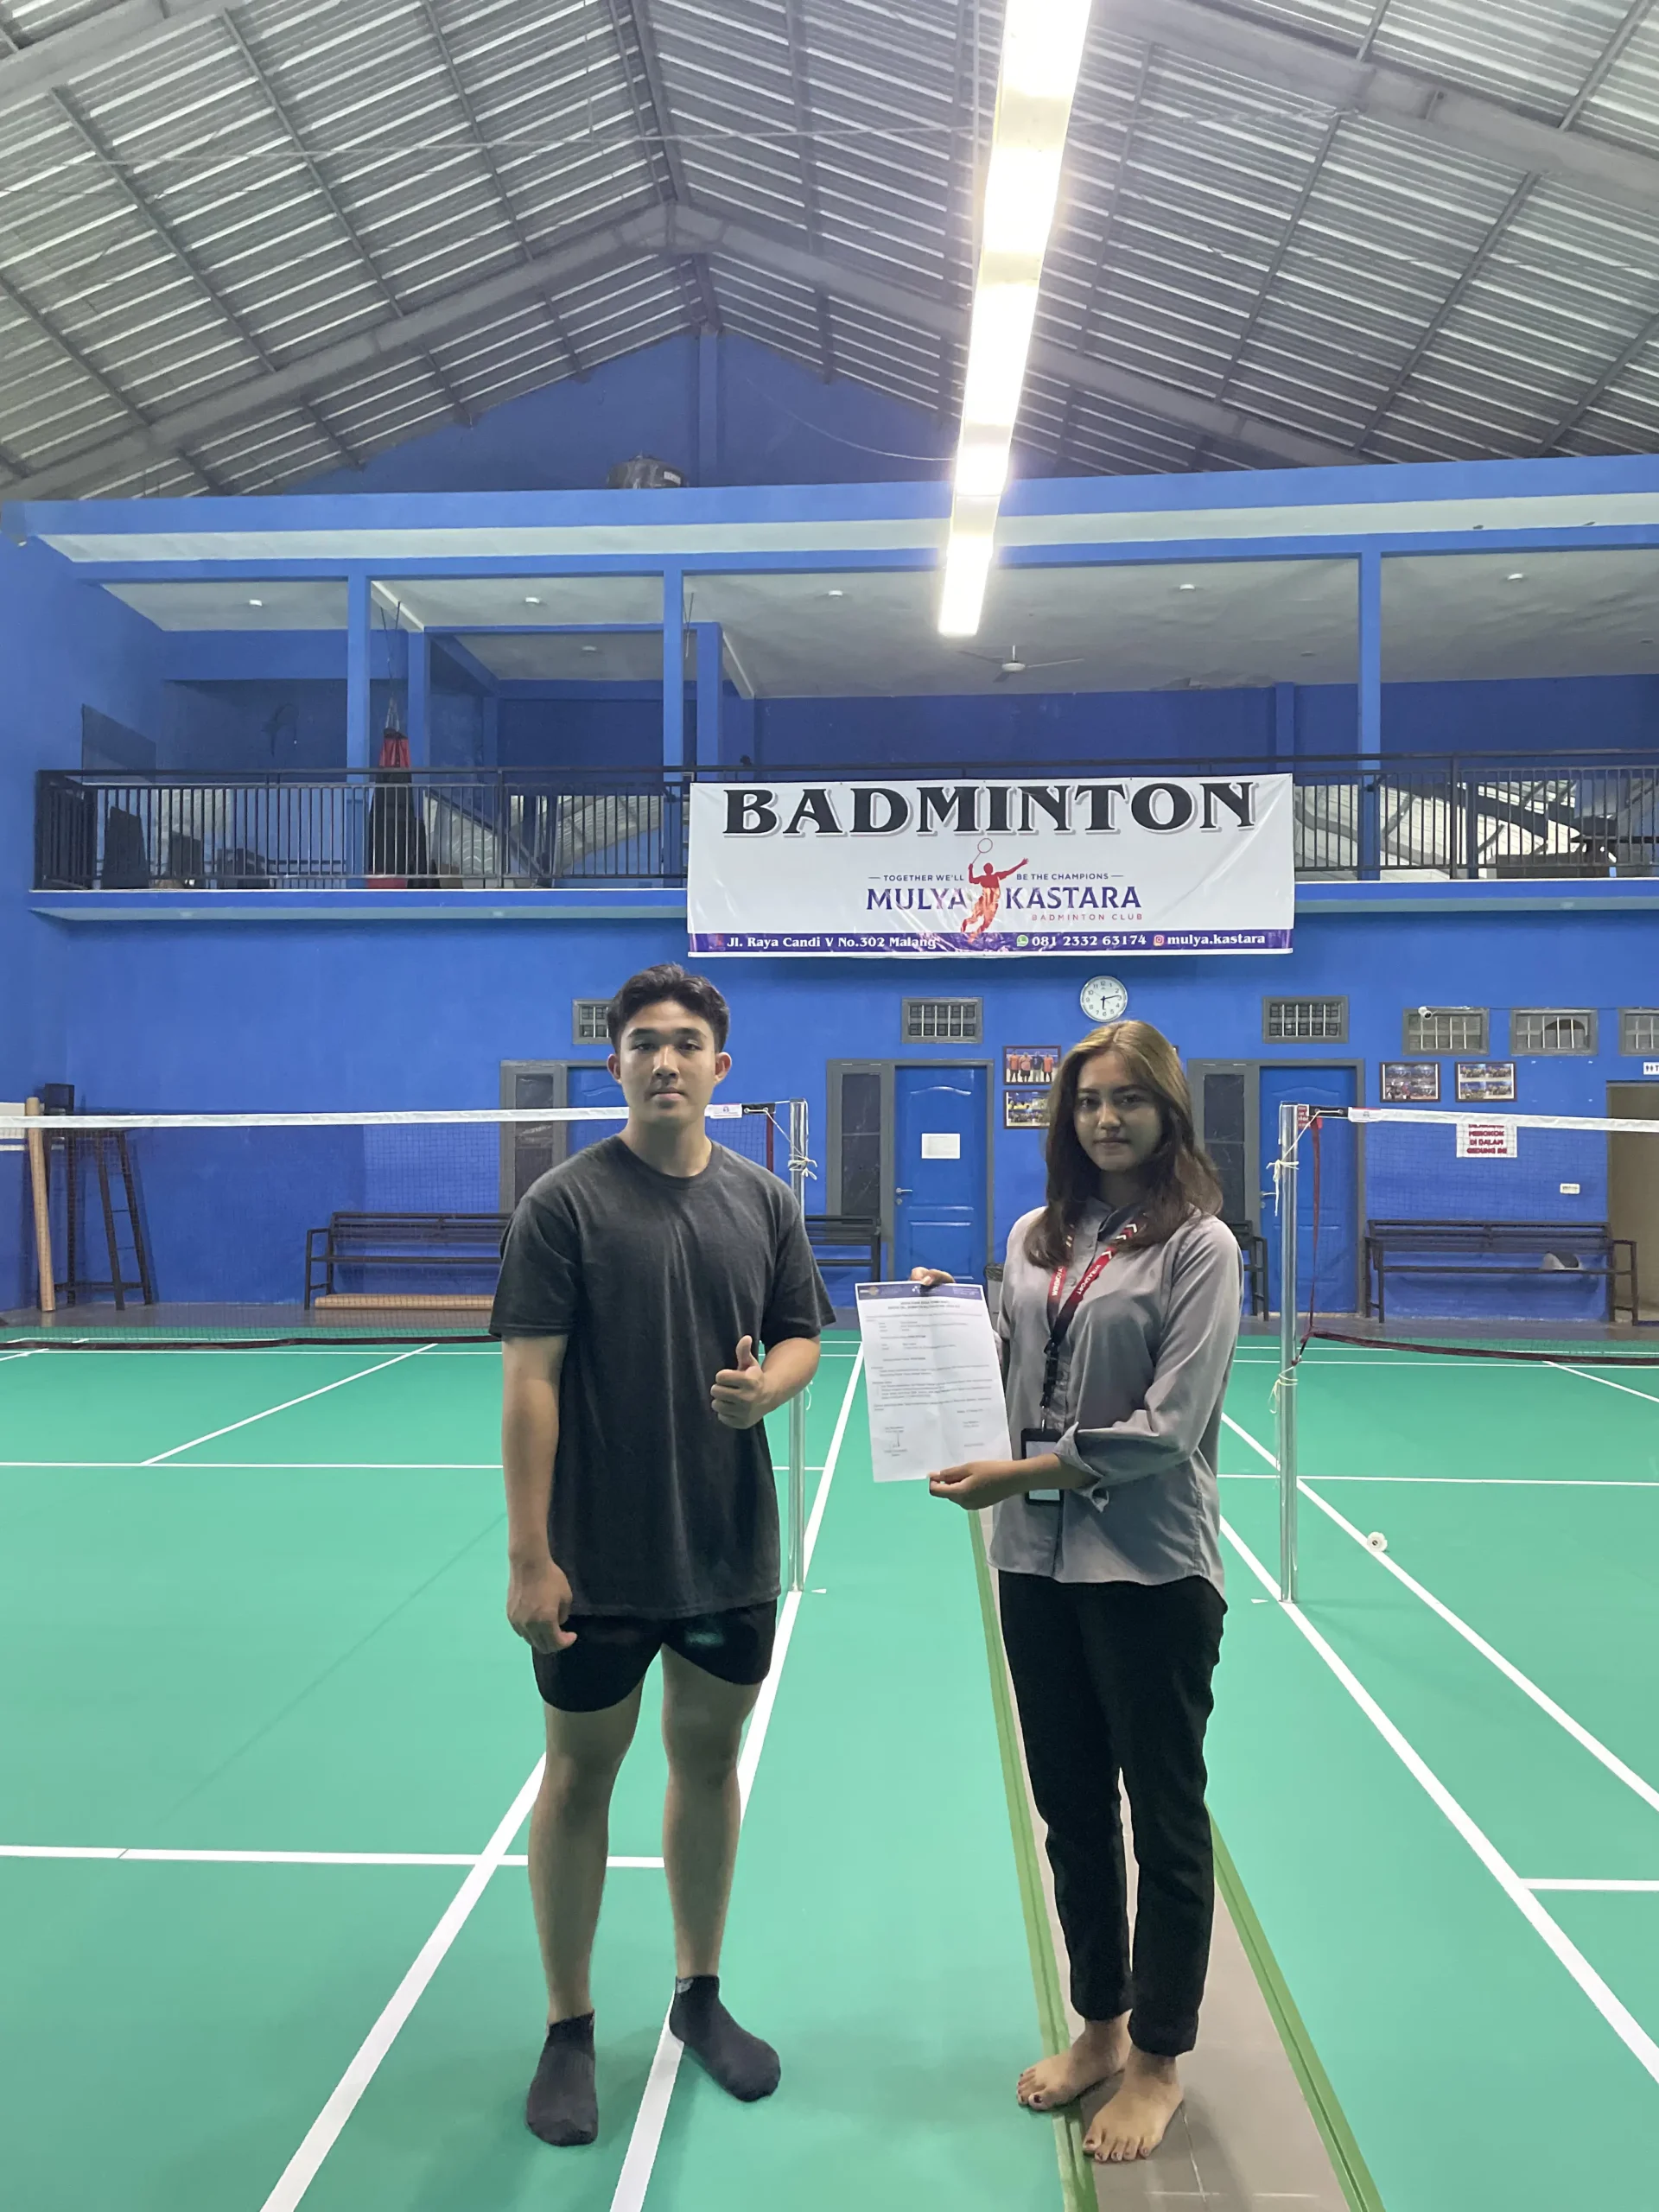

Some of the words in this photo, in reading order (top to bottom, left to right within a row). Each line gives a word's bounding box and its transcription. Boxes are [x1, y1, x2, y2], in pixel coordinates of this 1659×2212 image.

[723, 782, 1257, 836] BADMINTON
[866, 888, 967, 911] MULYA
[1006, 886, 1142, 910] KASTARA
[727, 937, 744, 948] Jl.
[747, 937, 779, 950] Raya
[782, 937, 821, 948] Candi
[824, 938, 834, 948] V
[838, 937, 885, 948] No.302
[889, 937, 937, 950] Malang
[1032, 936, 1057, 947] 081
[1063, 936, 1097, 946] 2332
[1102, 935, 1147, 946] 63174
[1167, 933, 1266, 946] mulya.kastara
